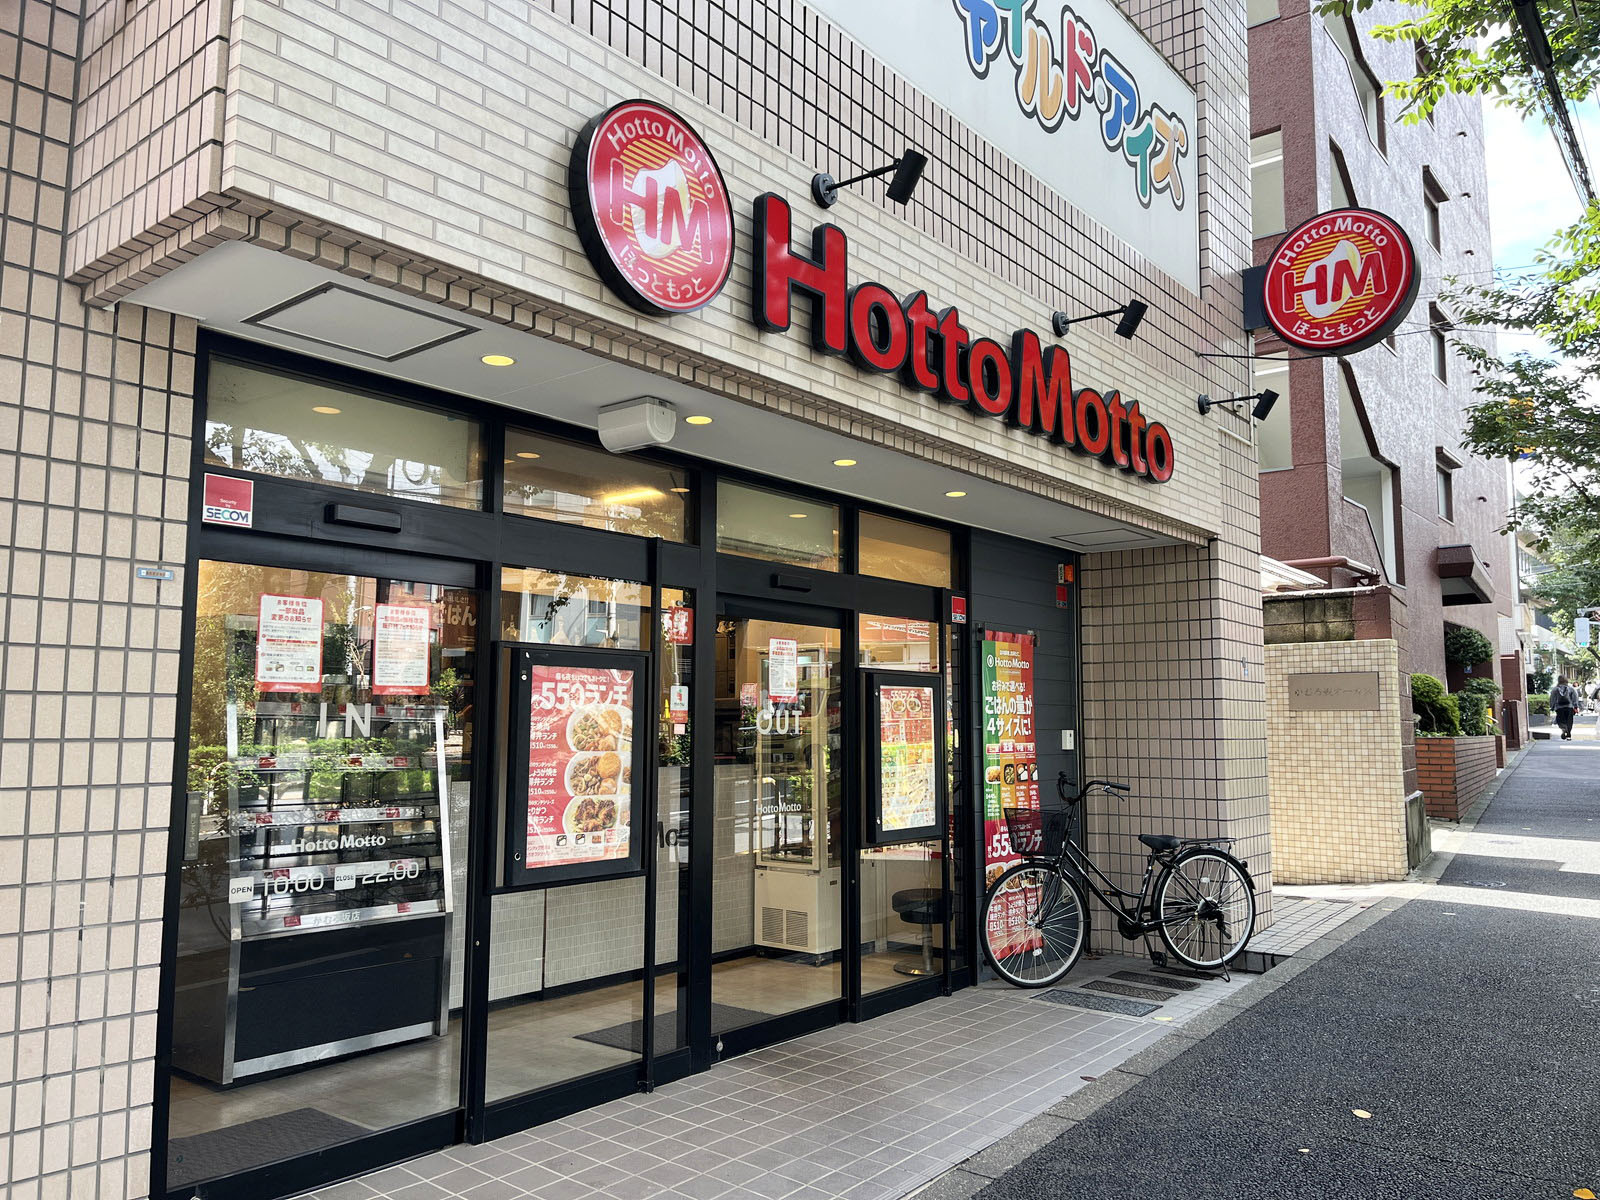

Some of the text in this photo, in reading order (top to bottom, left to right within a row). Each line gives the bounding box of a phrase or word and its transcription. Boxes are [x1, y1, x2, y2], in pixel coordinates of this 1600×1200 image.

[619, 244, 706, 300] ほっともっと
[1293, 306, 1381, 340] ほっともっと
[206, 507, 249, 523] SECOM
[985, 694, 1033, 715] ごはんの量が
[319, 702, 372, 738] IN
[757, 709, 802, 735] OUT
[987, 715, 1032, 737] 4サイズに!
[230, 886, 253, 895] OPEN
[336, 874, 354, 882] CLOSE
